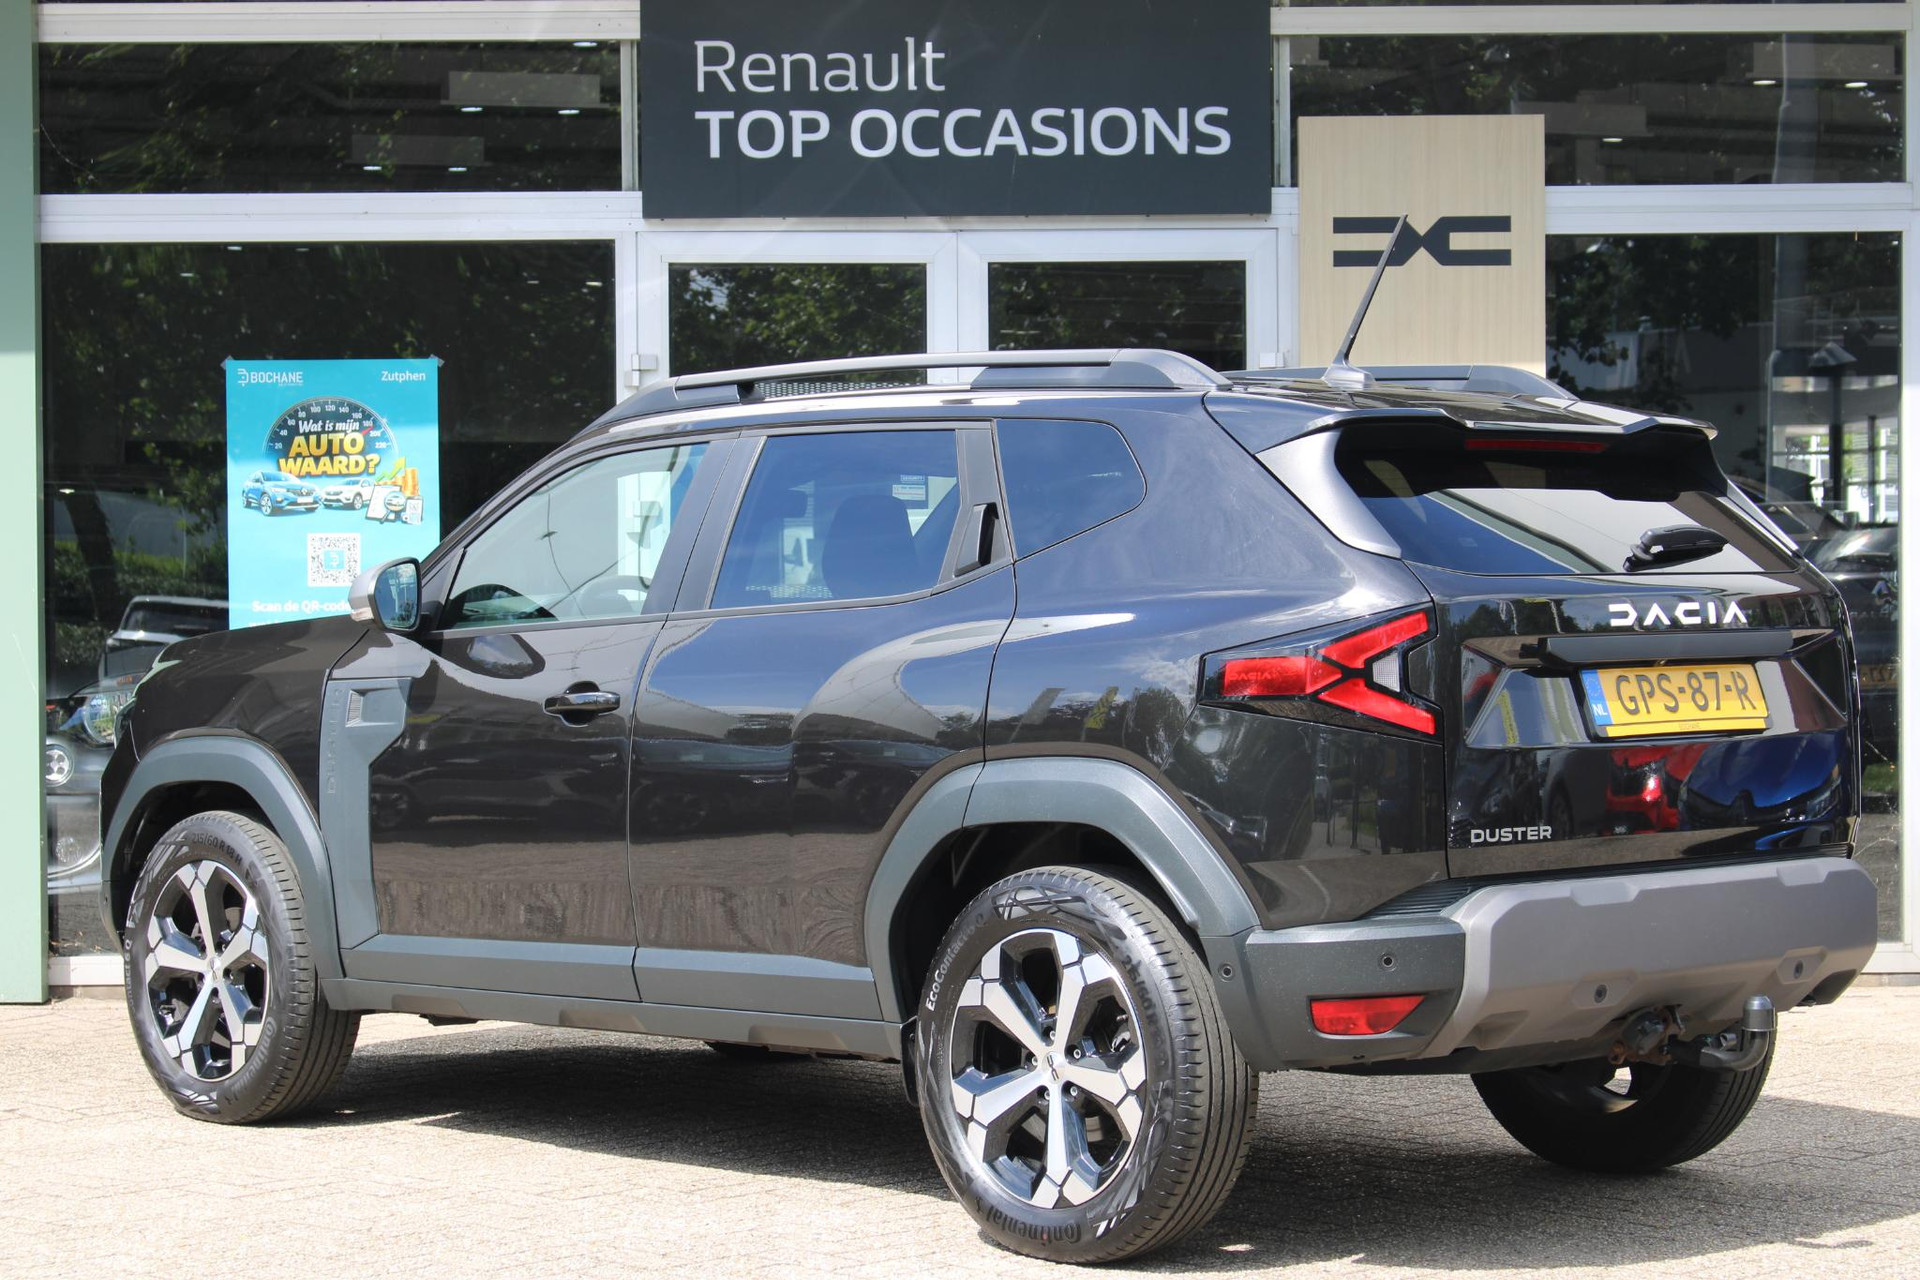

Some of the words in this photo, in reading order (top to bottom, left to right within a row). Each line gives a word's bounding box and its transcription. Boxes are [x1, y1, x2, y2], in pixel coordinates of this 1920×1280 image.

[695, 37, 945, 92] Renault
[695, 110, 830, 158] TOP
[850, 106, 1231, 158] OCCASIONS
[250, 371, 304, 384] BOCHANE
[381, 370, 426, 383] Zutphen
[299, 420, 321, 433] Wat
[325, 419, 333, 431] is
[336, 418, 360, 433] mijn
[288, 432, 364, 457] AUTO
[279, 453, 381, 476] WAARD?
[252, 600, 281, 612] Scan
[284, 600, 300, 612] de
[1608, 601, 1748, 627] DACIA
[1228, 671, 1272, 681] DACIA
[1615, 670, 1757, 716] GPS-87-R
[1592, 703, 1608, 716] NL
[1470, 825, 1552, 843] DUSTER
[985, 1203, 1083, 1246] Continental
